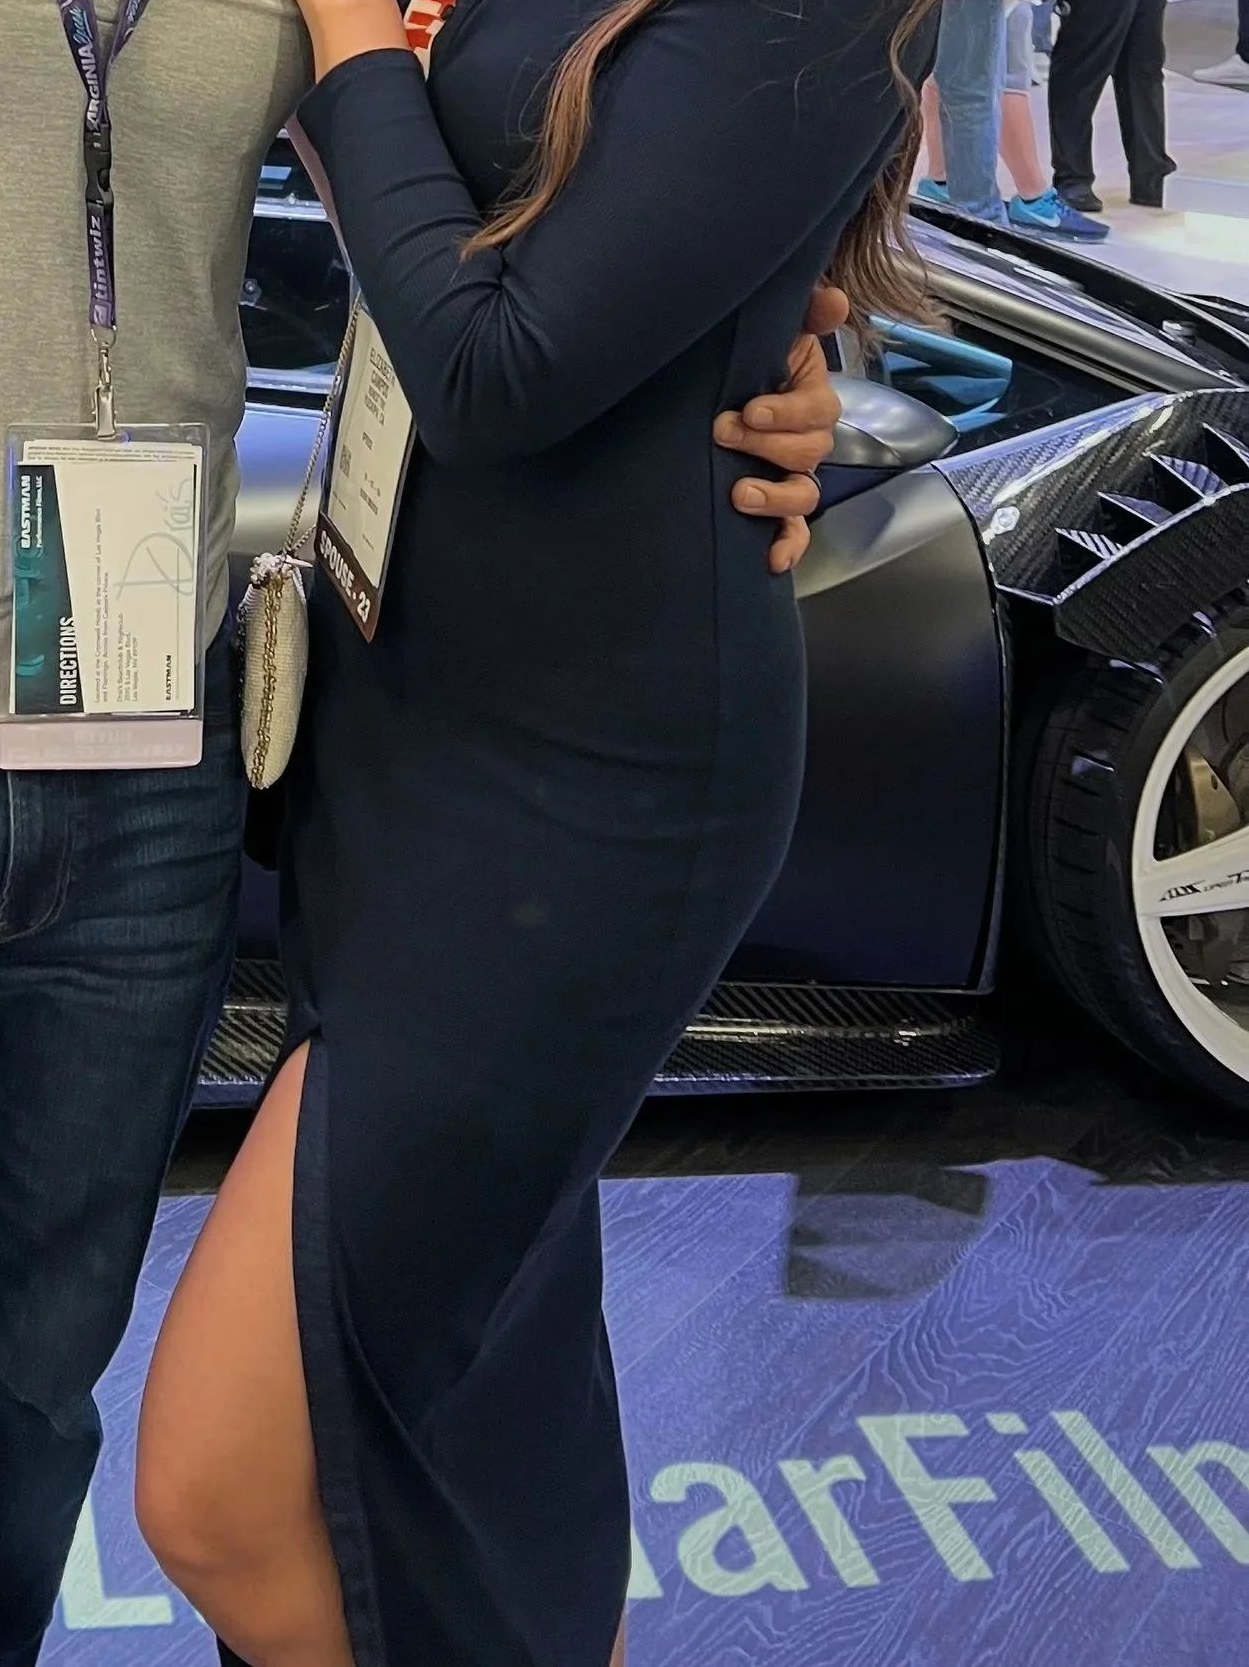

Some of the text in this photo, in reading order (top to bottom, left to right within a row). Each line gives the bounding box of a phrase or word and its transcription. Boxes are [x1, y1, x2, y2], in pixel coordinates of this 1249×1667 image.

[92, 214, 108, 300] tintwiz
[21, 475, 31, 549] EASTMAN
[319, 529, 371, 624] SPOUSE 23
[59, 616, 77, 706] DIRECTIONS
